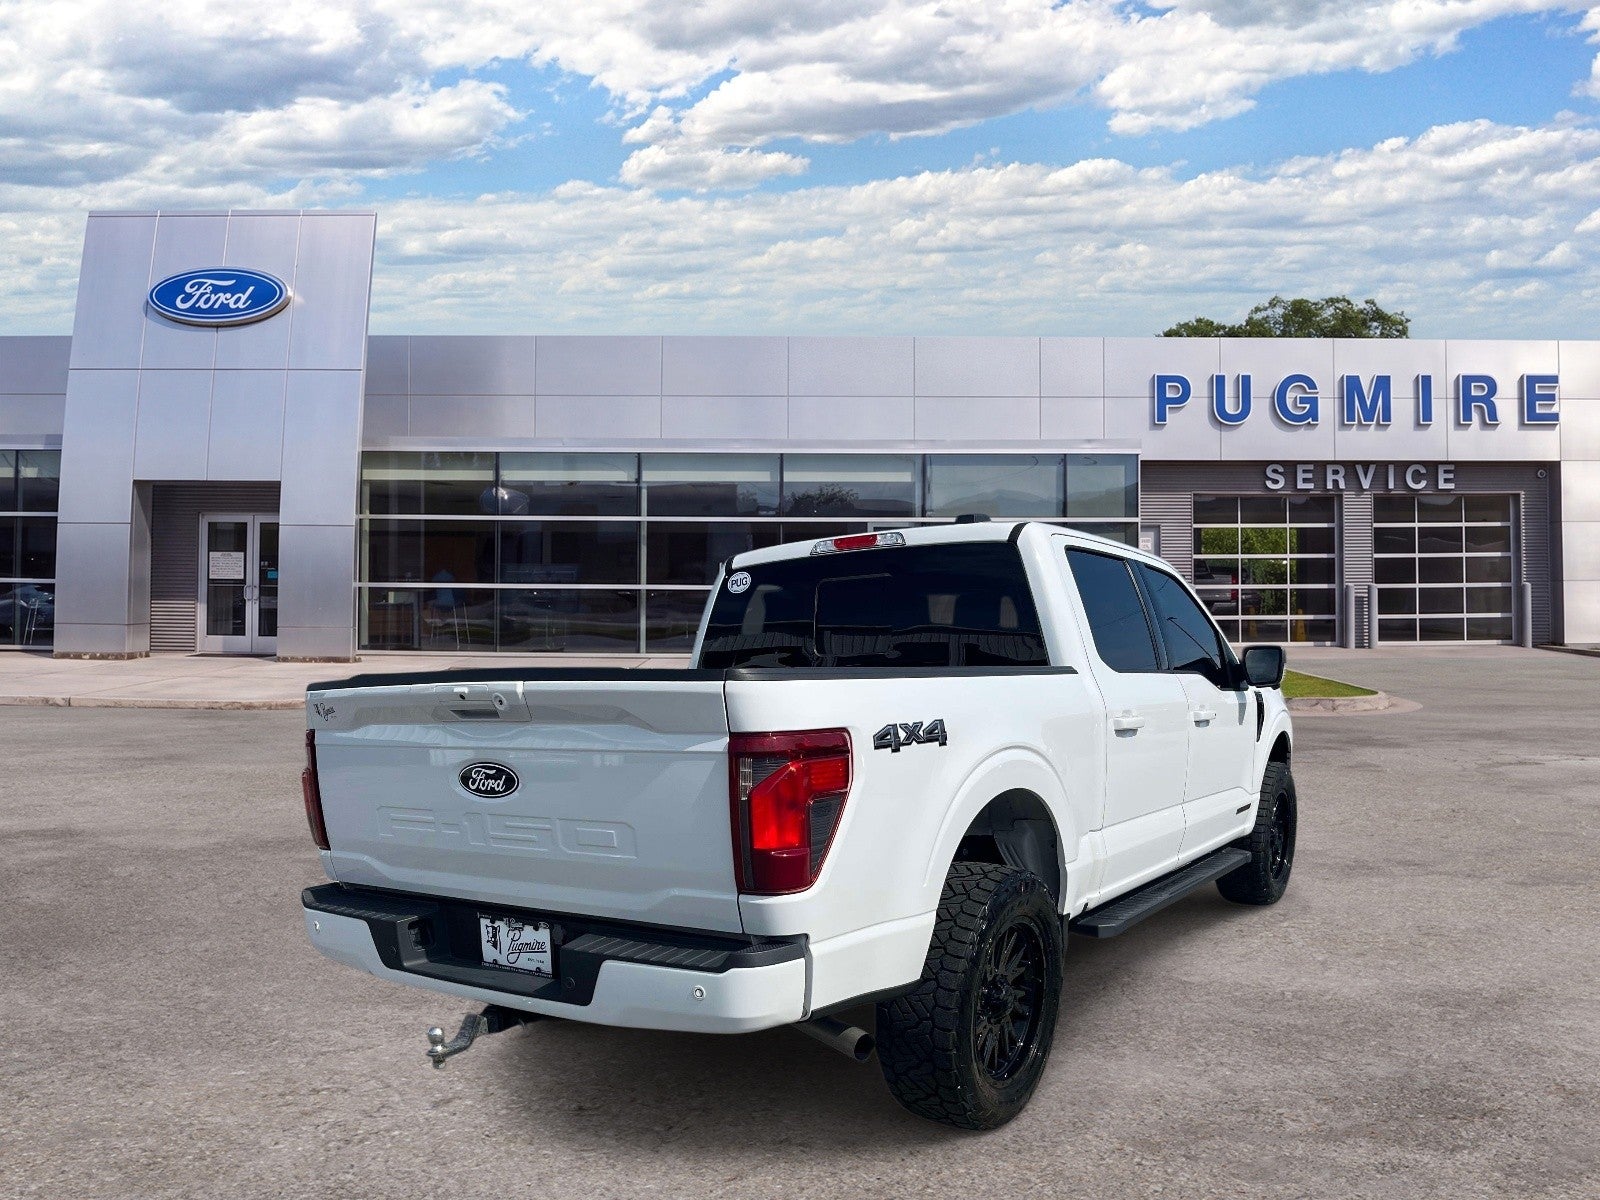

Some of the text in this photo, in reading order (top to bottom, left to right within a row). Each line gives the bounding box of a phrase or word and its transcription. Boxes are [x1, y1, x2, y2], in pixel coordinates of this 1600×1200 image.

[175, 278, 255, 309] Ford
[1153, 373, 1561, 426] PUGMIRE
[1264, 463, 1457, 491] SERVICE
[731, 576, 749, 589] PUG
[468, 767, 506, 792] Ford
[506, 928, 547, 965] Pugmire
